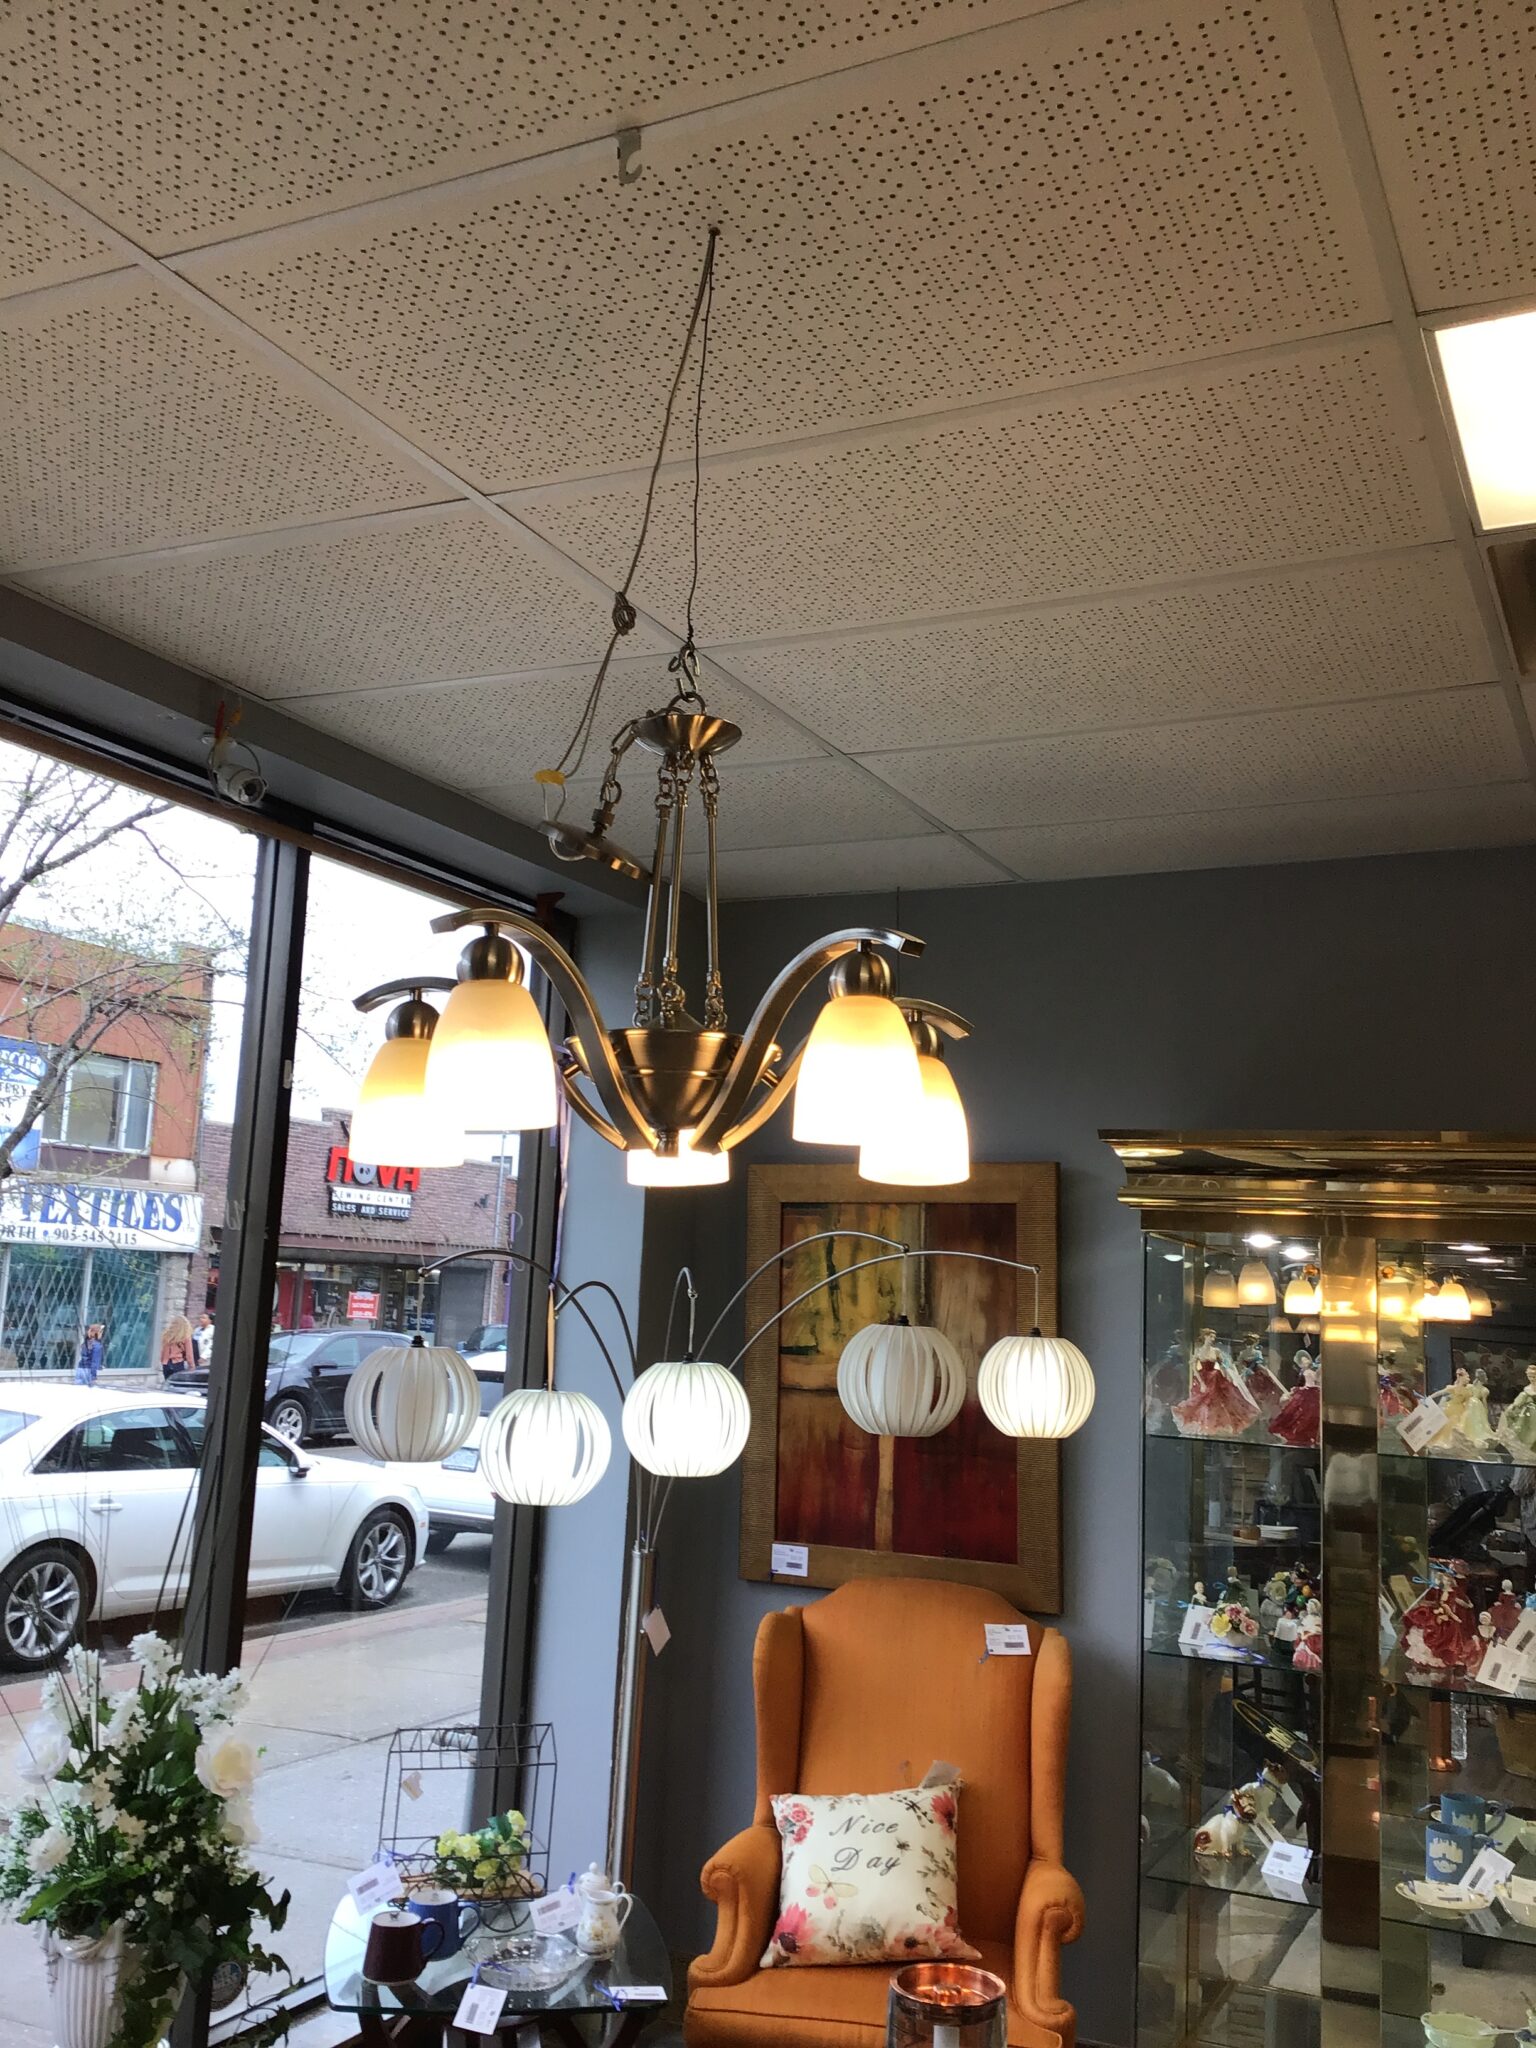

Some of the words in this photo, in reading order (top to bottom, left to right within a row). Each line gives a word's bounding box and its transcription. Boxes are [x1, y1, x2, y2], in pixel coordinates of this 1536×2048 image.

[333, 1189, 371, 1201] SEWING
[19, 1181, 183, 1232] TEXTILES
[332, 1202, 357, 1214] SALES
[360, 1205, 376, 1215] AND
[378, 1206, 411, 1218] SERVICE
[829, 1815, 899, 1836] Nice
[830, 1847, 901, 1876] Day
